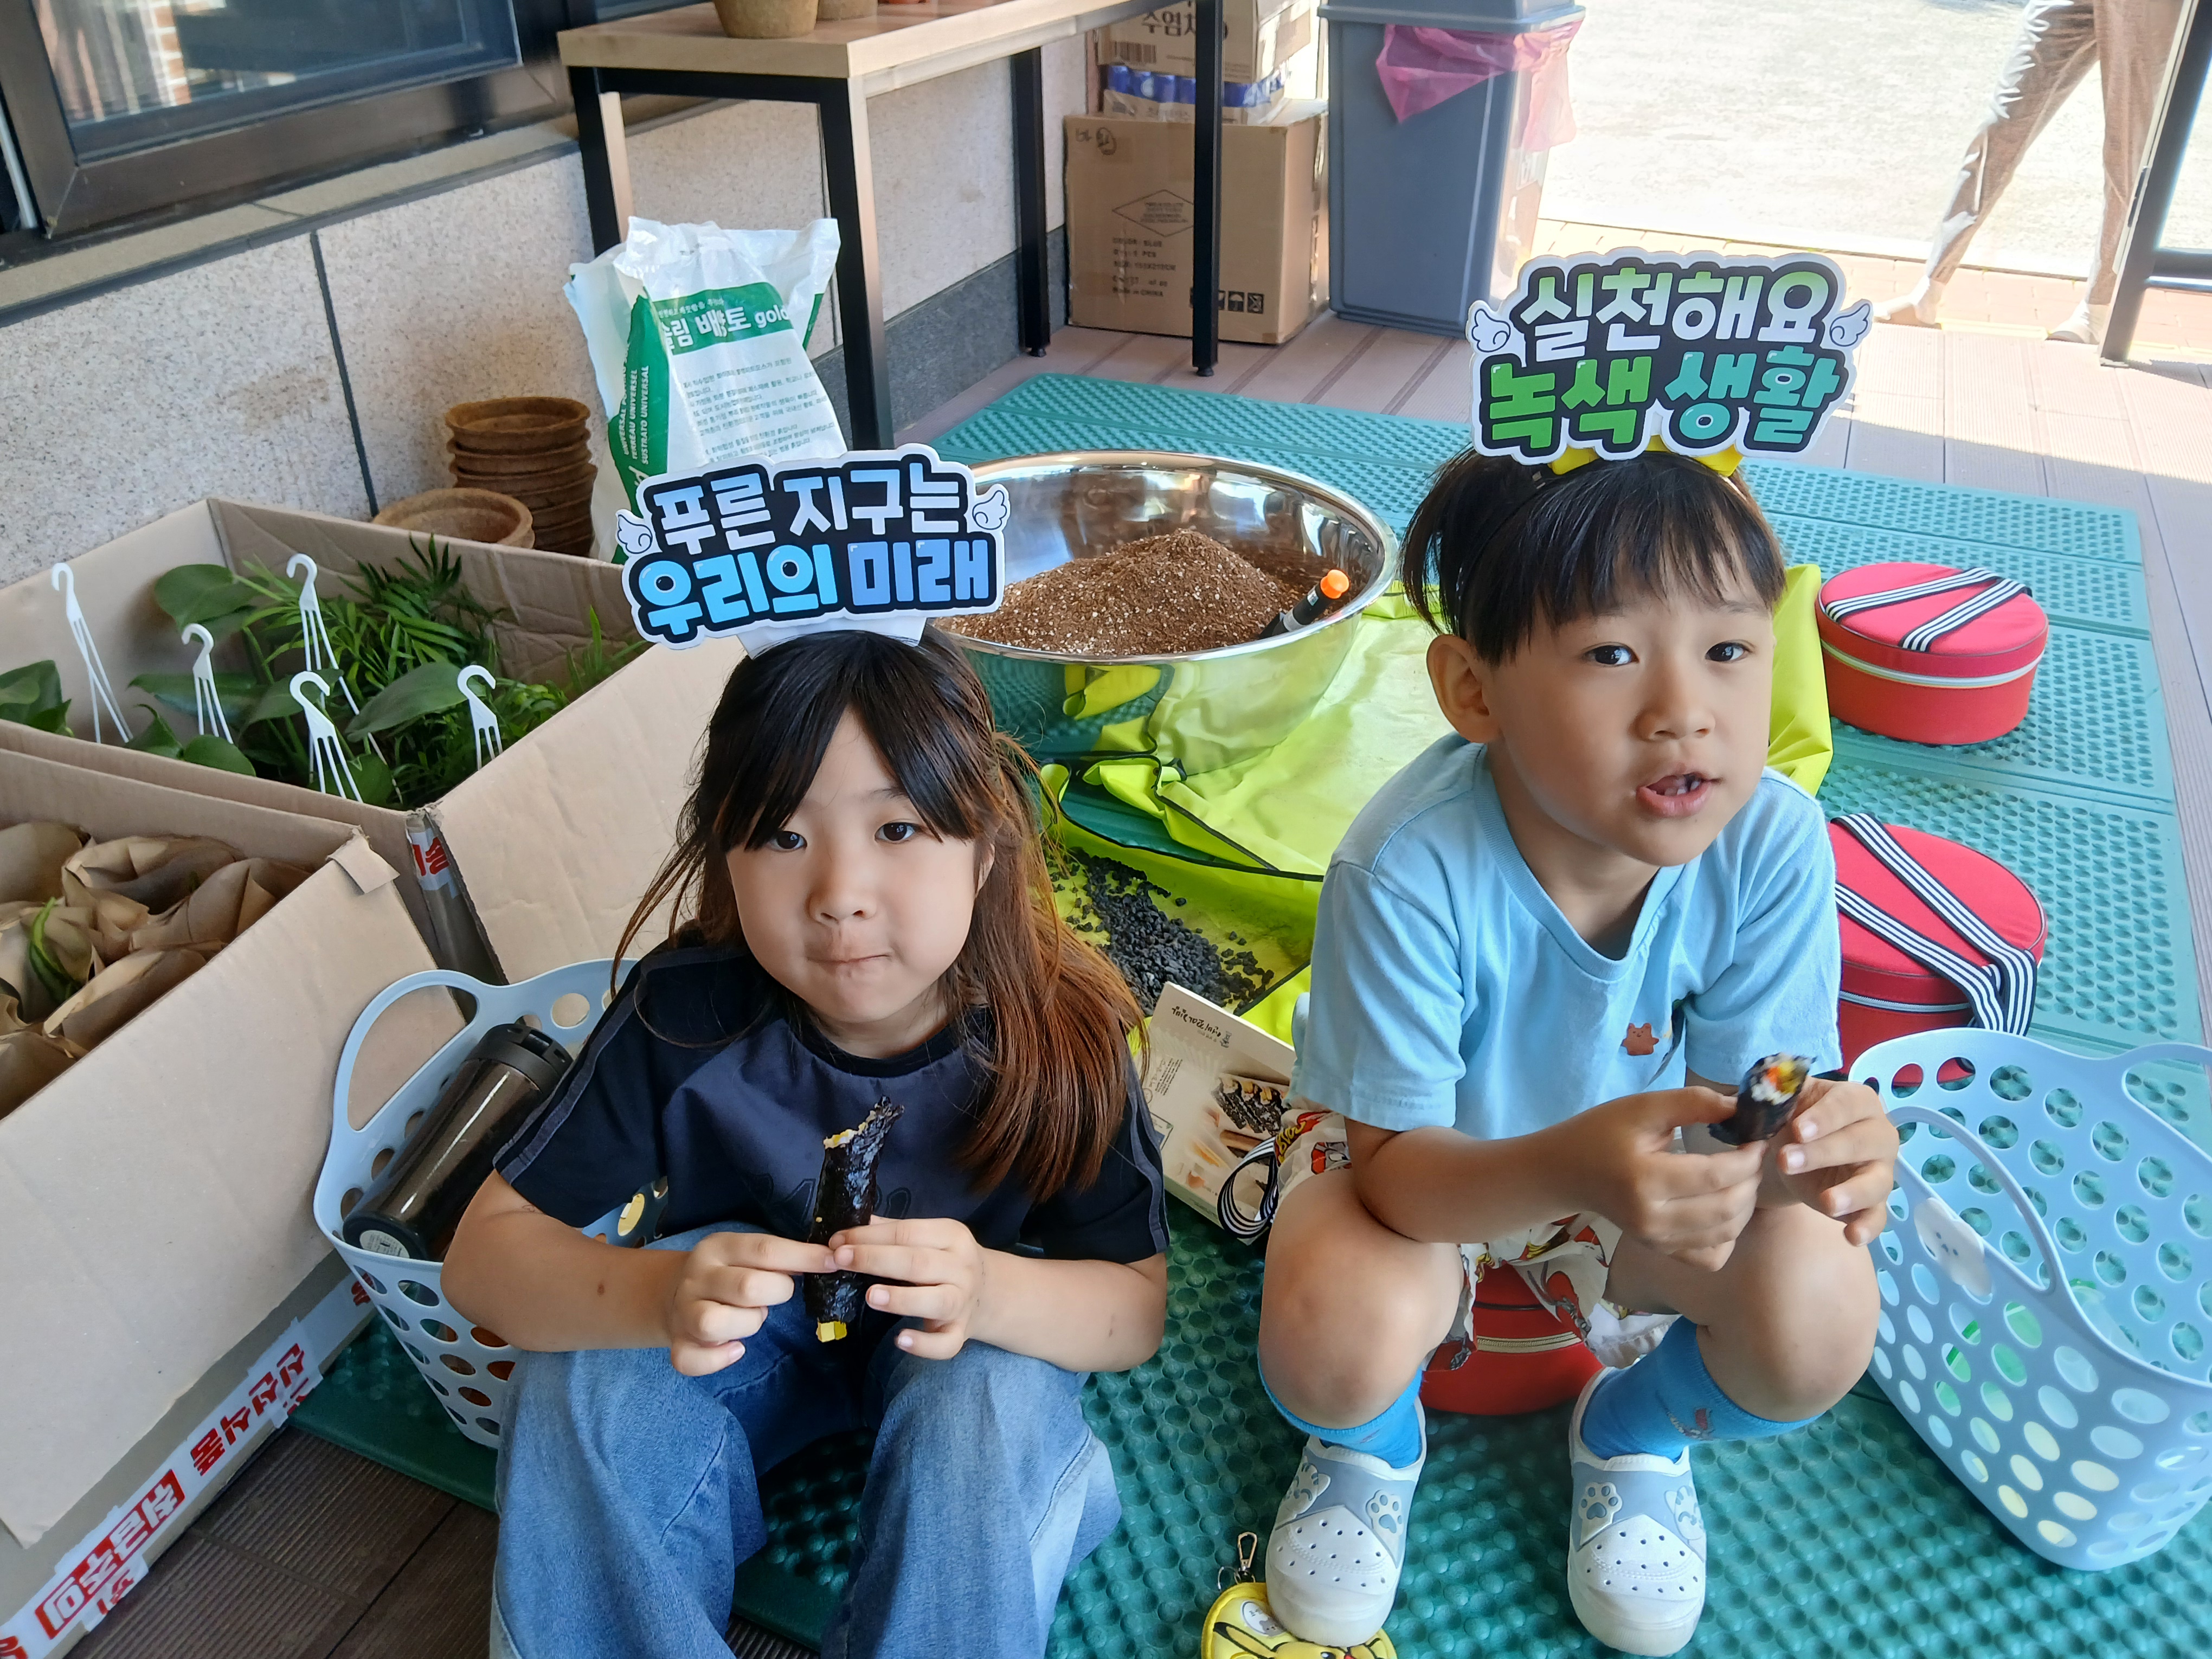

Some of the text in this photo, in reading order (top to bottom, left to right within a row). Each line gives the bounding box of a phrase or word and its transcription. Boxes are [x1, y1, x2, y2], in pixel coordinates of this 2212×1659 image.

[1520, 267, 1829, 362] 실천해요
[619, 408, 629, 455] UNIVERSAL
[629, 369, 638, 460] TERREAU UNIVERSEL
[640, 365, 649, 465] SUSTRATO UNIVERSAL
[1489, 345, 1840, 448] 녹색 생활
[654, 462, 960, 555] 푸른 지구는
[639, 539, 989, 635] 우리의 미래
[43, 1343, 305, 1630] 신선식품 취급주의
